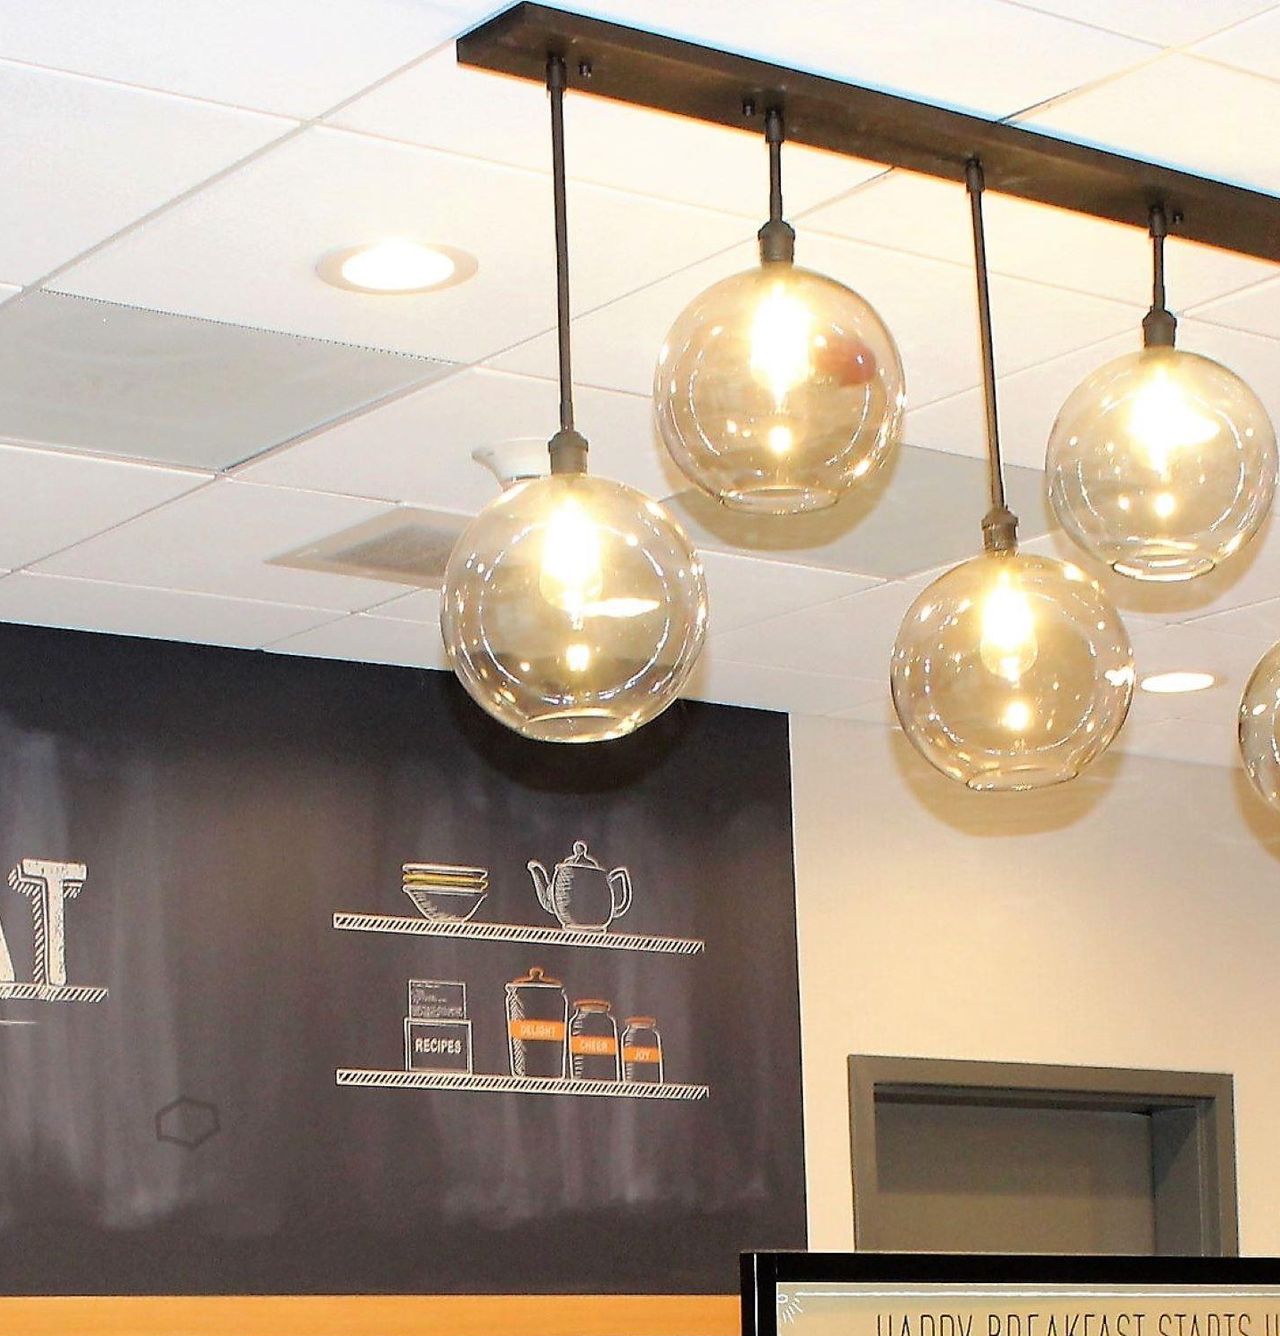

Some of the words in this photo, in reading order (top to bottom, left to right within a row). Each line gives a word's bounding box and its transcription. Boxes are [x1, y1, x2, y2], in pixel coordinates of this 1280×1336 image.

[521, 1024, 556, 1038] DELIGHT
[415, 1037, 462, 1054] RECIPES
[580, 1040, 608, 1050] CHEER
[633, 1050, 651, 1061] JOY
